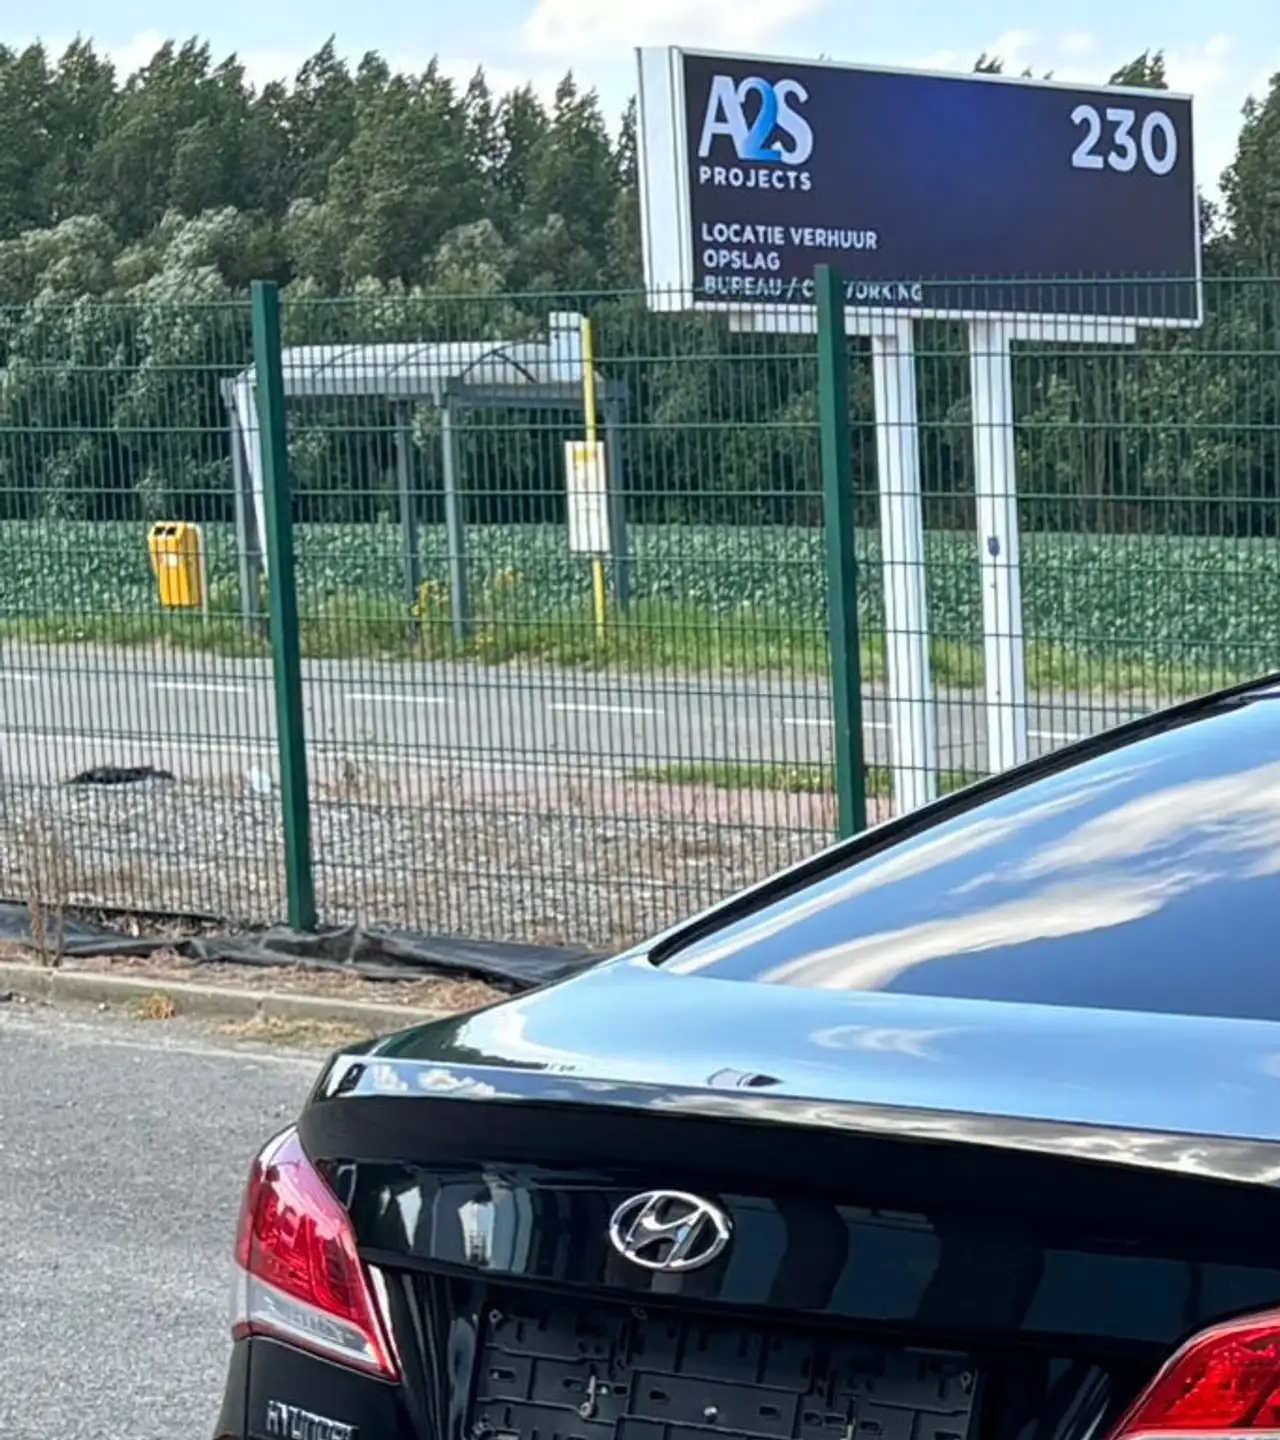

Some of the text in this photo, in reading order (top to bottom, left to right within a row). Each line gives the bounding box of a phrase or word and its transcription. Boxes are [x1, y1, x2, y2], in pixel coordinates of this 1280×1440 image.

[698, 75, 813, 165] A2S
[1070, 104, 1177, 175] 230
[699, 165, 812, 191] PROJECTS
[702, 222, 878, 249] LOCATIE VERHUUR
[703, 249, 781, 271] OPSLAG
[703, 275, 782, 296] BUREAU
